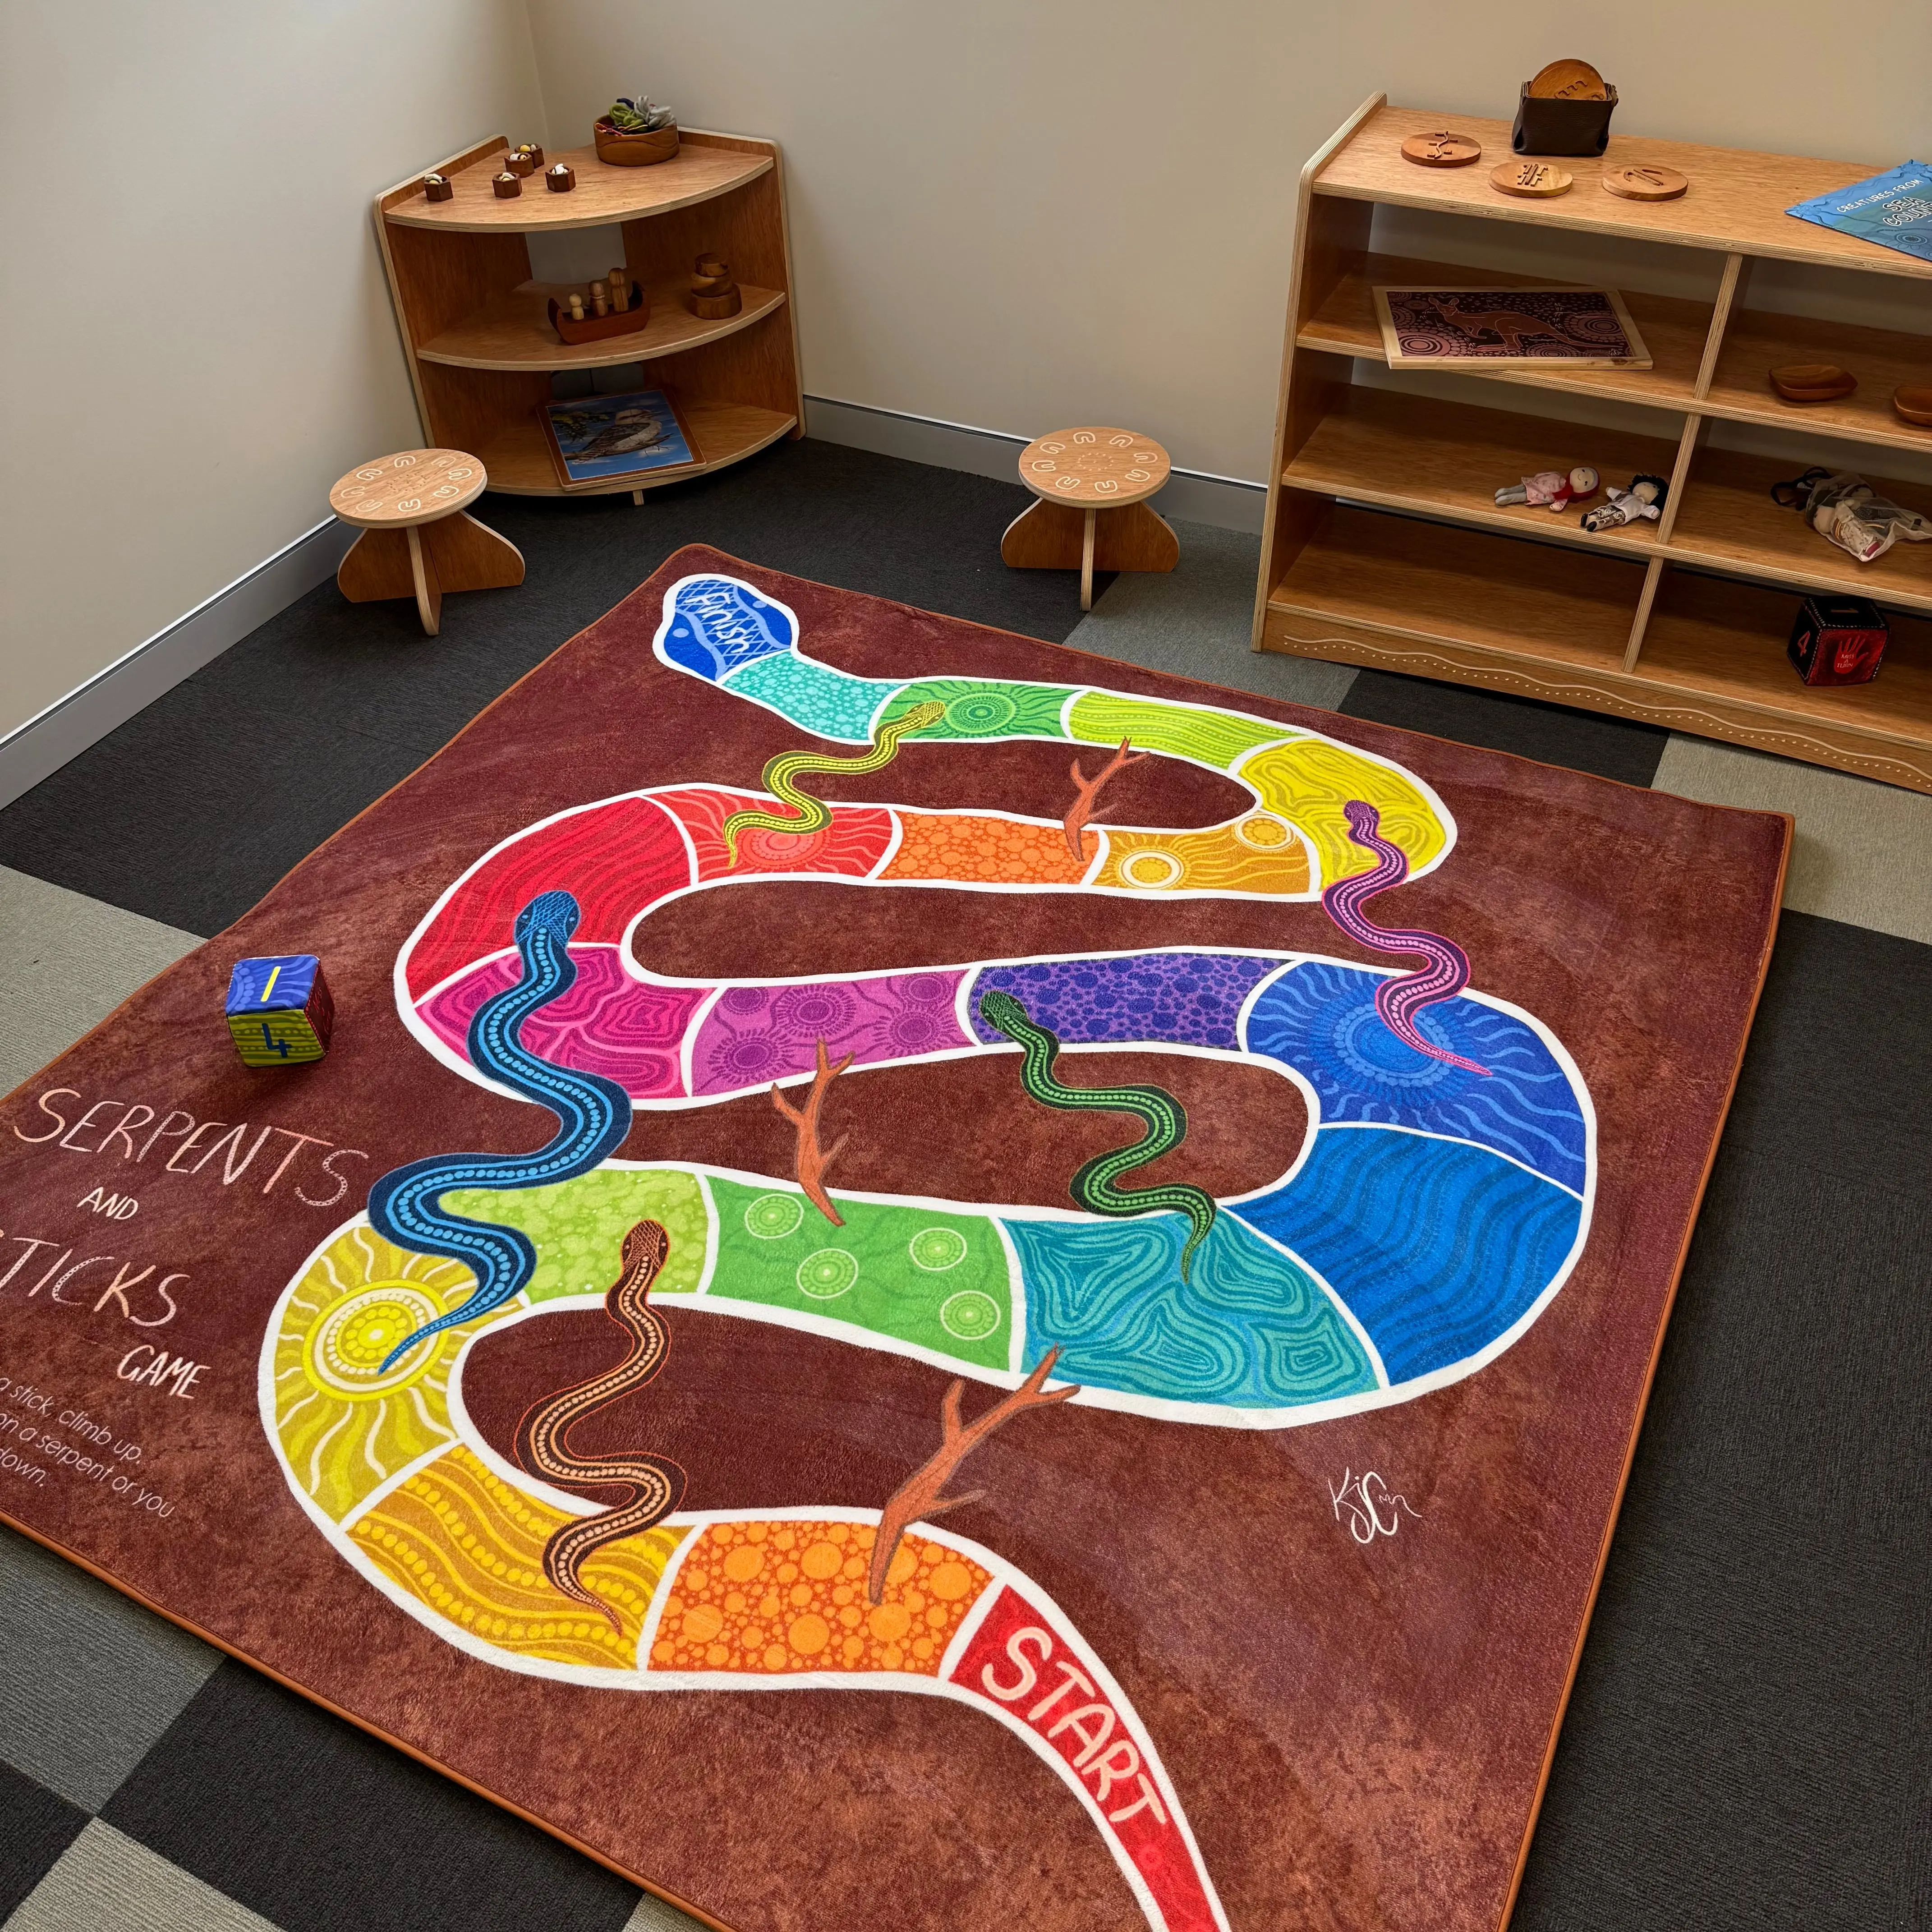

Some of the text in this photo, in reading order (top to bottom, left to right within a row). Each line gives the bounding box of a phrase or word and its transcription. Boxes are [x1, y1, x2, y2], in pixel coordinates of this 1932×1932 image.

[1837, 179, 1924, 212] CREATURES FROM
[1882, 197, 1926, 212] SEA
[1798, 630, 1810, 657] 4
[260, 966, 281, 1002] 1
[261, 1023, 293, 1058] 4
[14, 1088, 368, 1206] SERPENTS
[77, 1187, 138, 1219] AND
[0, 1228, 190, 1326] TICKS
[117, 1345, 211, 1399] GAME
[9, 1385, 54, 1417] stick,
[59, 1410, 112, 1444] climb
[114, 1439, 142, 1464] up.
[19, 1427, 38, 1441] a
[36, 1435, 115, 1481] serpent
[112, 1476, 137, 1494] or
[131, 1488, 175, 1518] you
[981, 1626, 1167, 1825] START
